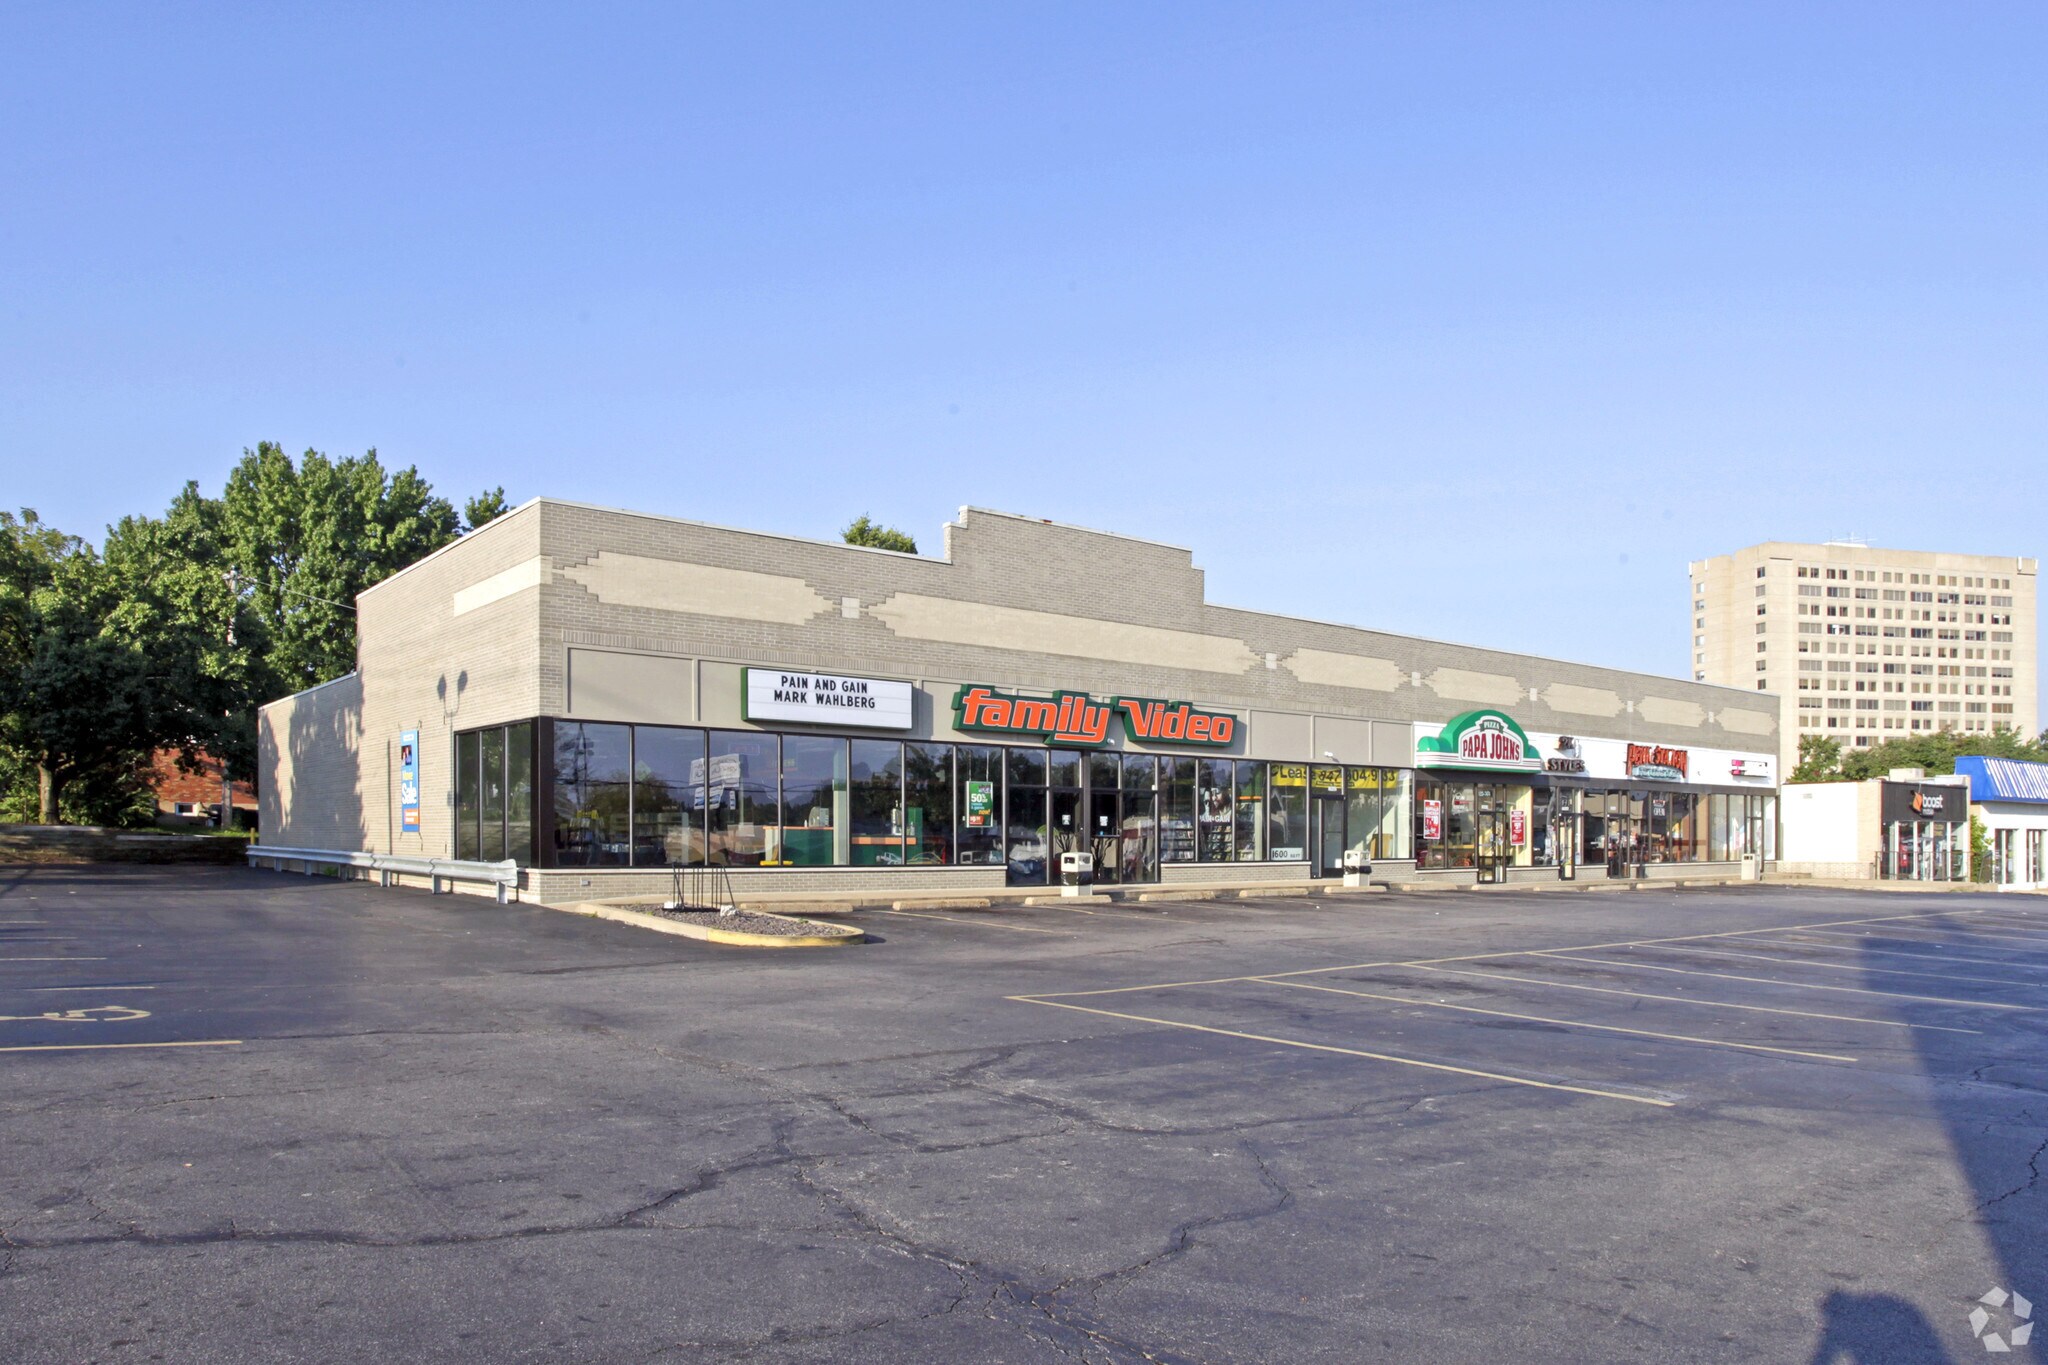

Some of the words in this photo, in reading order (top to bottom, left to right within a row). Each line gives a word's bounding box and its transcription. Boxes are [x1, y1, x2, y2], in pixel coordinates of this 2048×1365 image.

[781, 675, 808, 689] PAIN
[814, 679, 837, 692] AND
[841, 681, 868, 694] GAIN
[774, 689, 808, 704] MARK
[815, 693, 876, 709] WAHLBERG
[962, 688, 1111, 744] family
[1118, 699, 1234, 743] Video
[1483, 720, 1500, 729] PIZZA
[1463, 733, 1488, 759] PAPA
[1547, 757, 1586, 773] STYLES
[402, 781, 417, 804] Sale
[1922, 794, 1943, 808] boost
